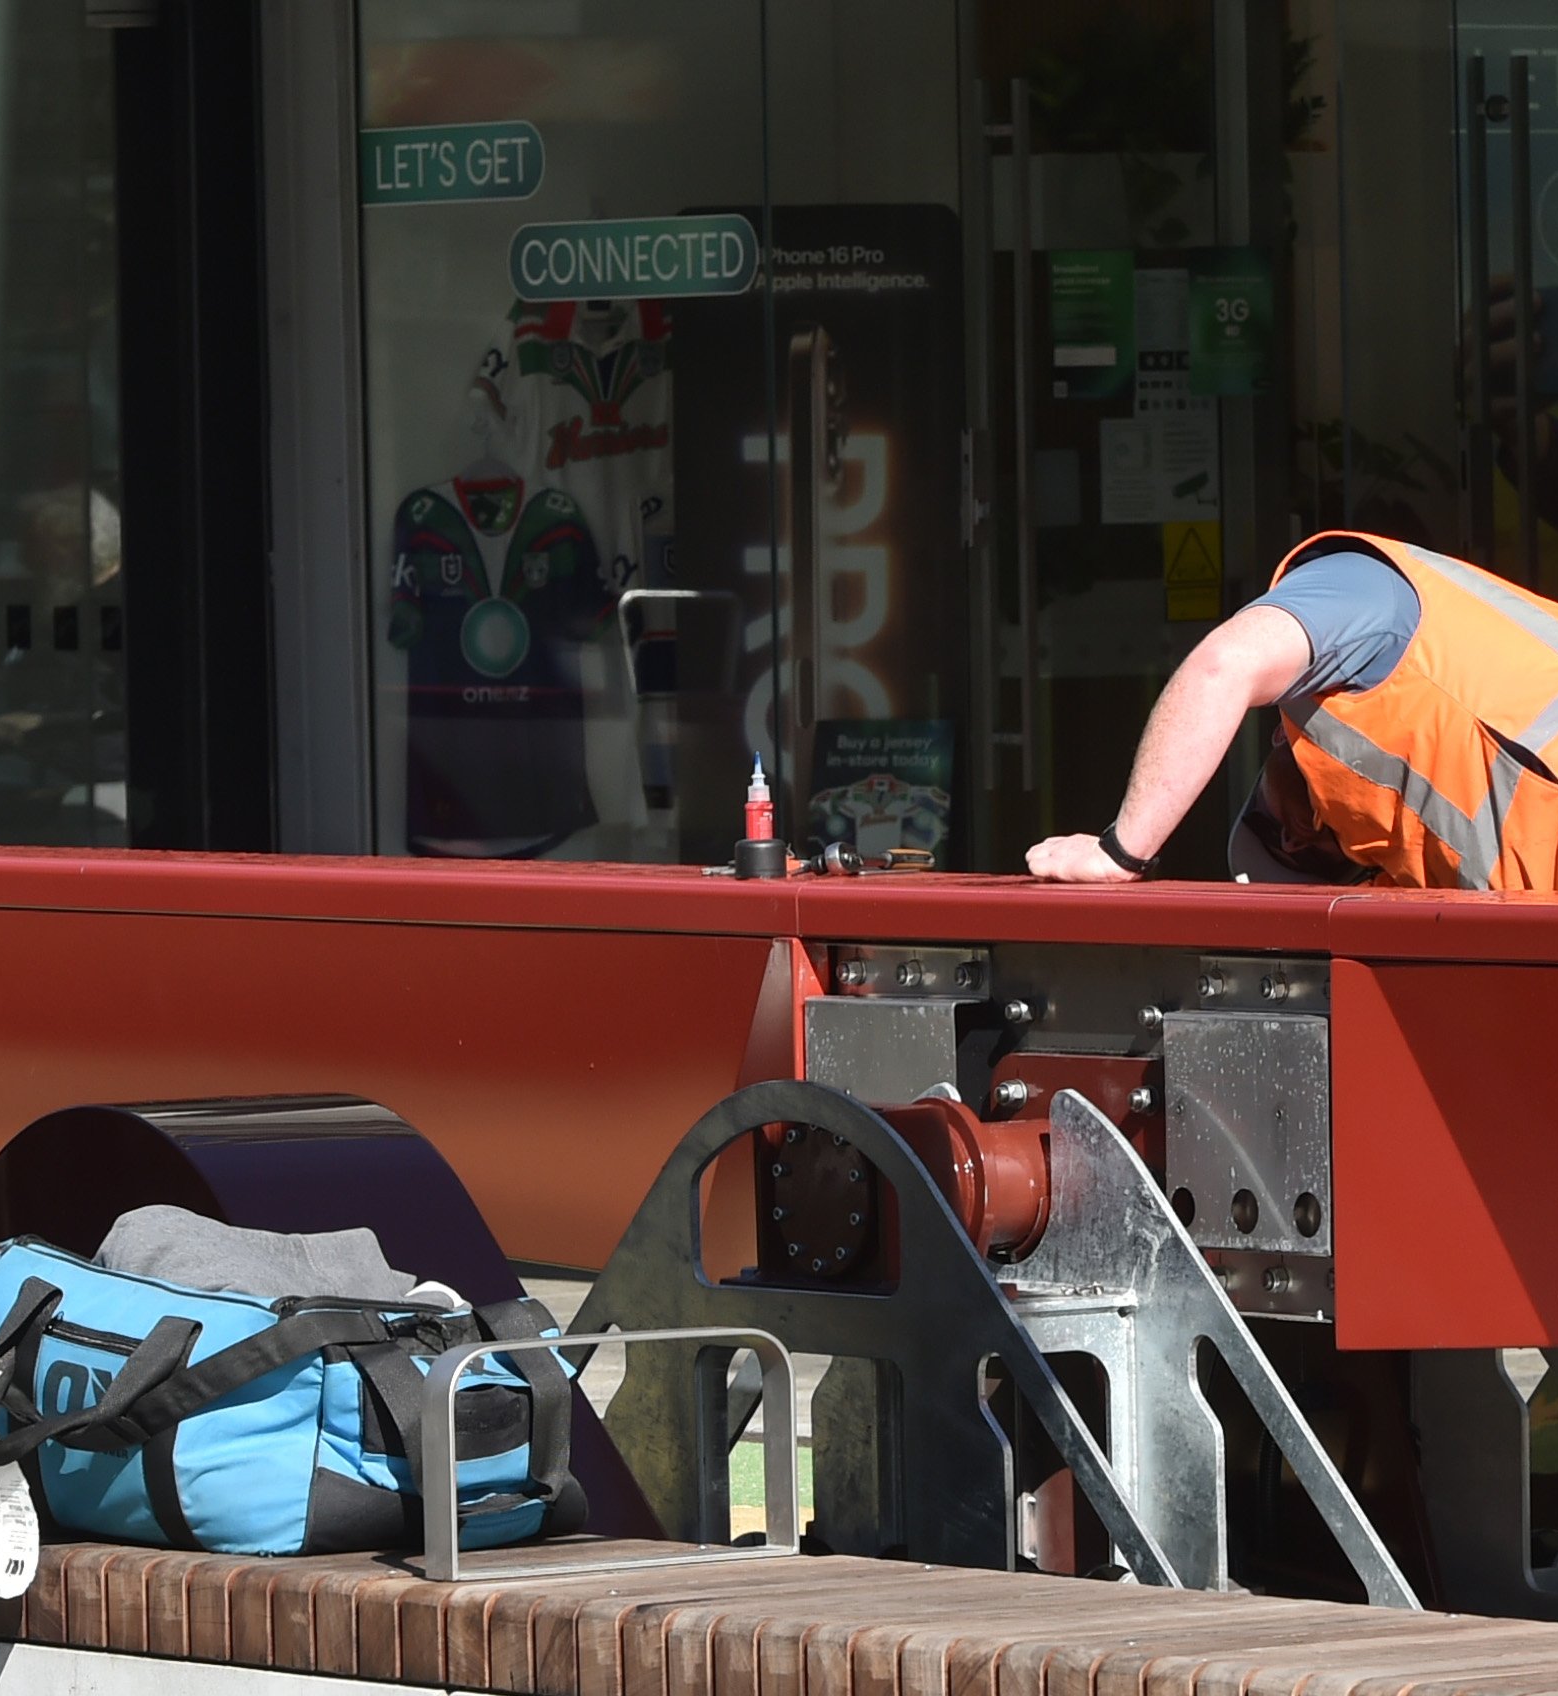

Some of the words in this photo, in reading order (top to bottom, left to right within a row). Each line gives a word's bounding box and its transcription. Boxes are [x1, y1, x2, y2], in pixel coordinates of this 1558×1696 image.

[375, 140, 457, 190] LET'S
[465, 137, 530, 187] GET
[520, 232, 745, 285] CONNECTED
[829, 246, 848, 264] 16
[853, 246, 885, 264] Pro
[817, 273, 930, 293] Intelligence.
[1215, 298, 1250, 322] 3G
[837, 735, 867, 751] Buy
[893, 752, 940, 770] today
